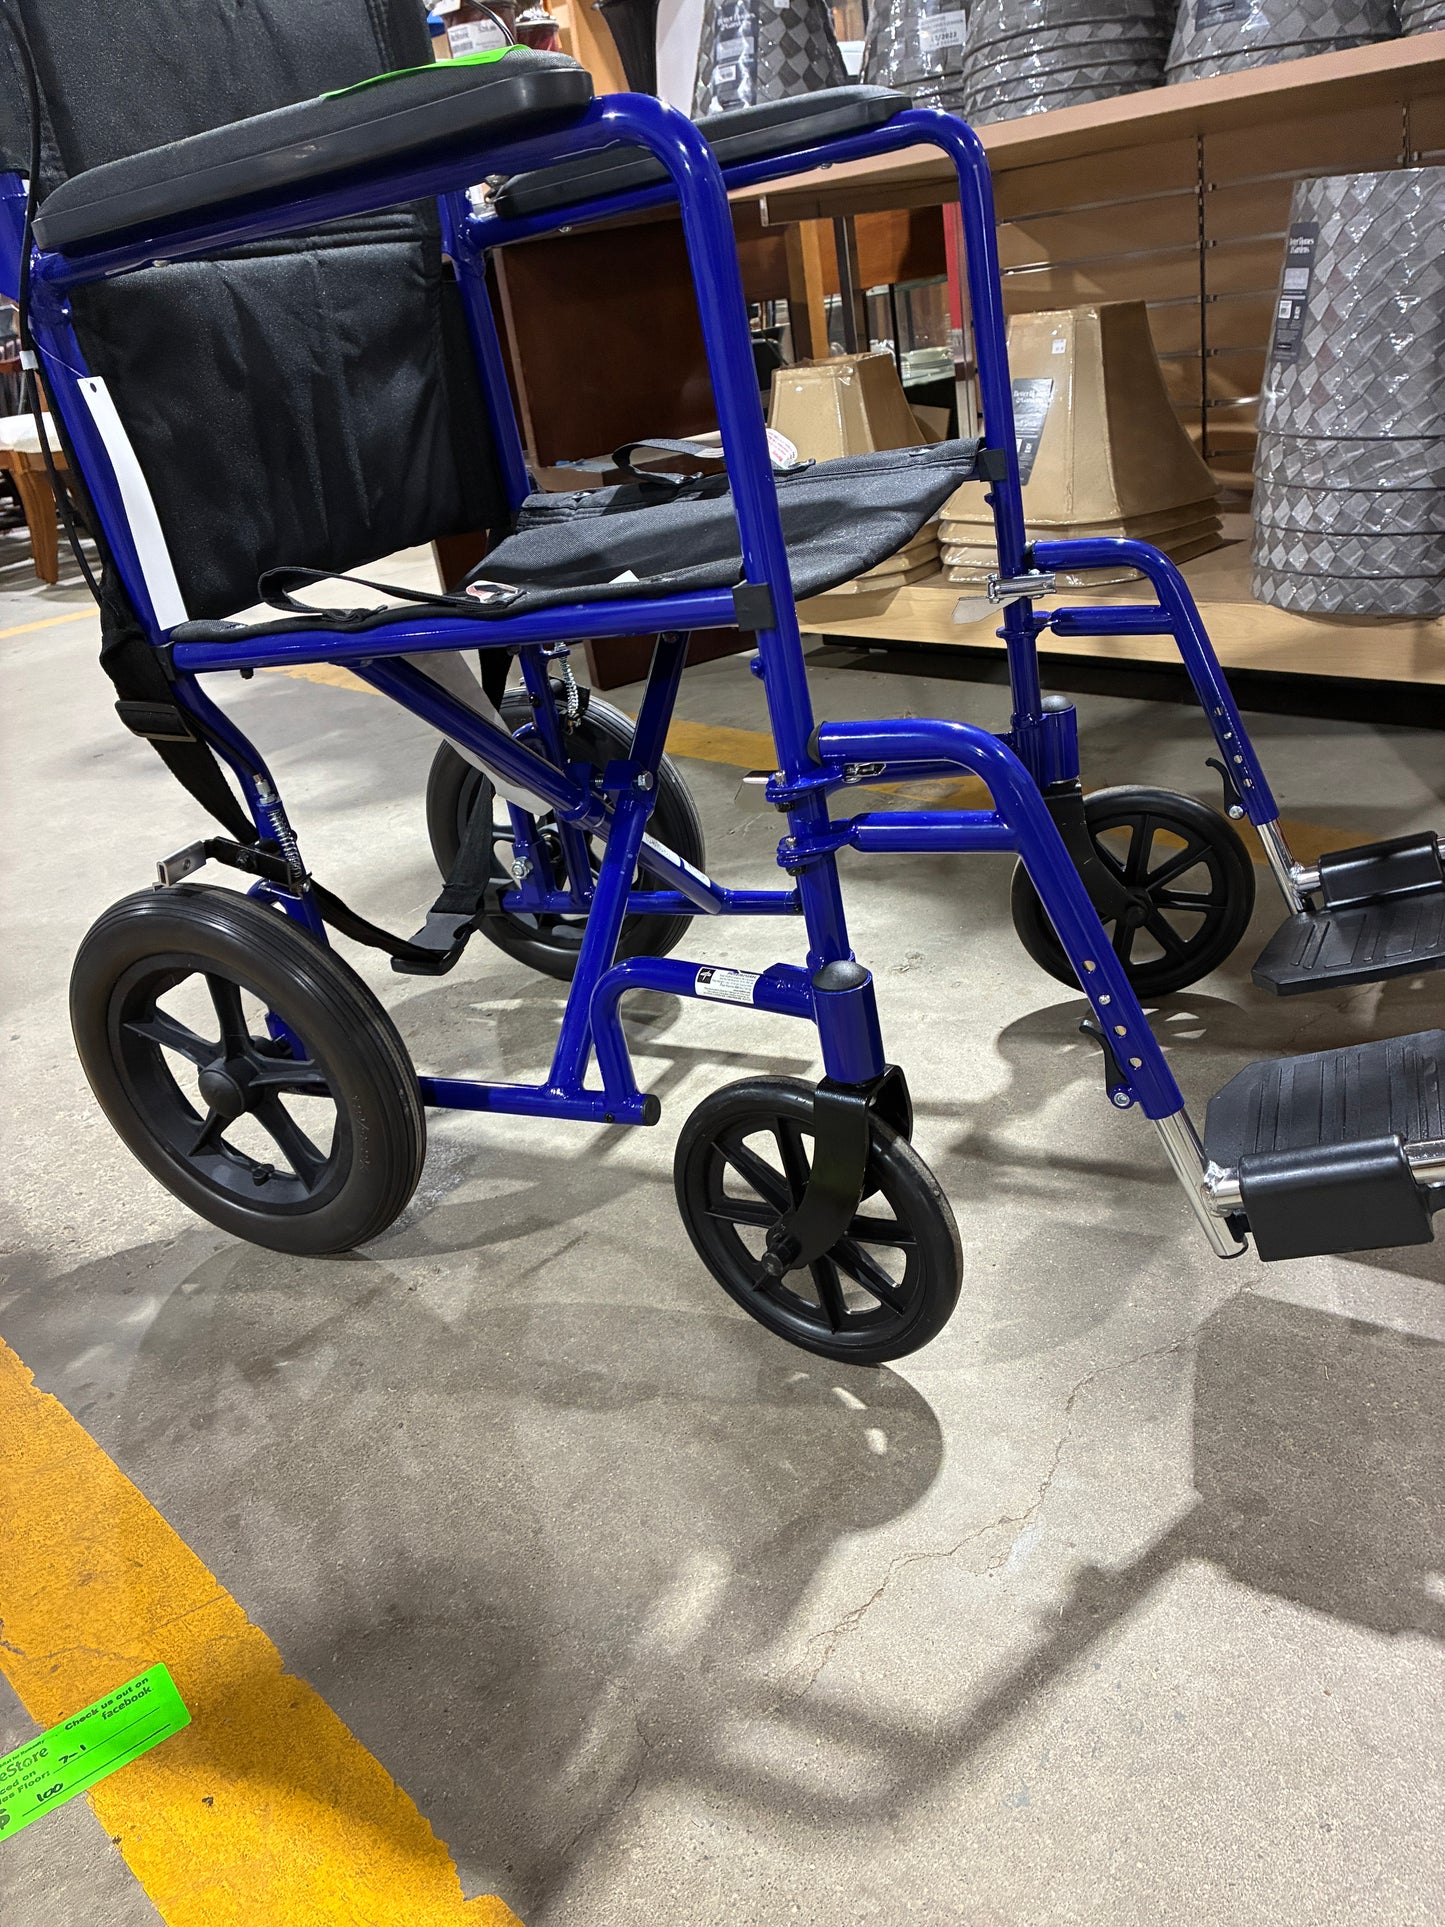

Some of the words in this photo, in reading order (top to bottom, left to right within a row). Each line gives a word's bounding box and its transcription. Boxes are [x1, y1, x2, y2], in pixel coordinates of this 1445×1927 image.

[64, 1707, 99, 1731] Check
[101, 1699, 114, 1709] us
[116, 1686, 134, 1701] out
[135, 1677, 149, 1688] on
[102, 1686, 152, 1720] facebook
[17, 1770, 51, 1794] Floor:
[22, 1770, 37, 1781] on
[36, 1782, 64, 1802] 100
